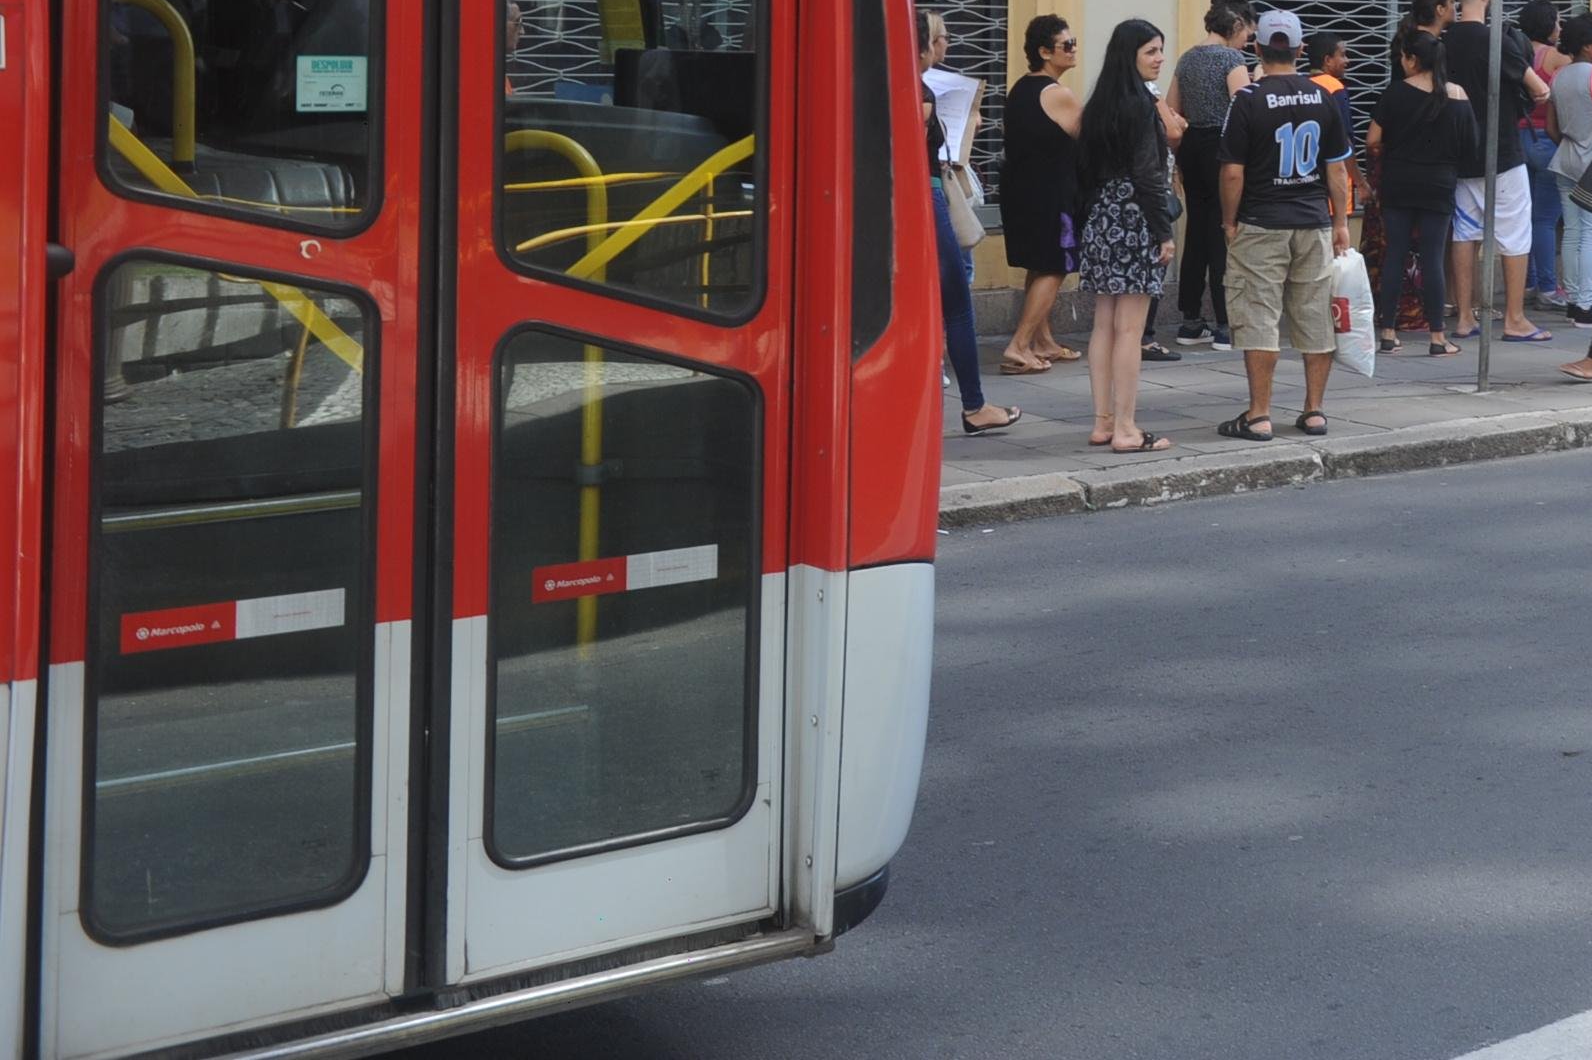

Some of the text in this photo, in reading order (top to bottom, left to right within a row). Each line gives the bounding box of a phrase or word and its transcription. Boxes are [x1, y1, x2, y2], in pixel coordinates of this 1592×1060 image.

[1266, 90, 1322, 109] Banrisul
[1275, 120, 1321, 178] 10
[556, 575, 601, 589] Marcopolo
[150, 623, 205, 637] Marcopolo
